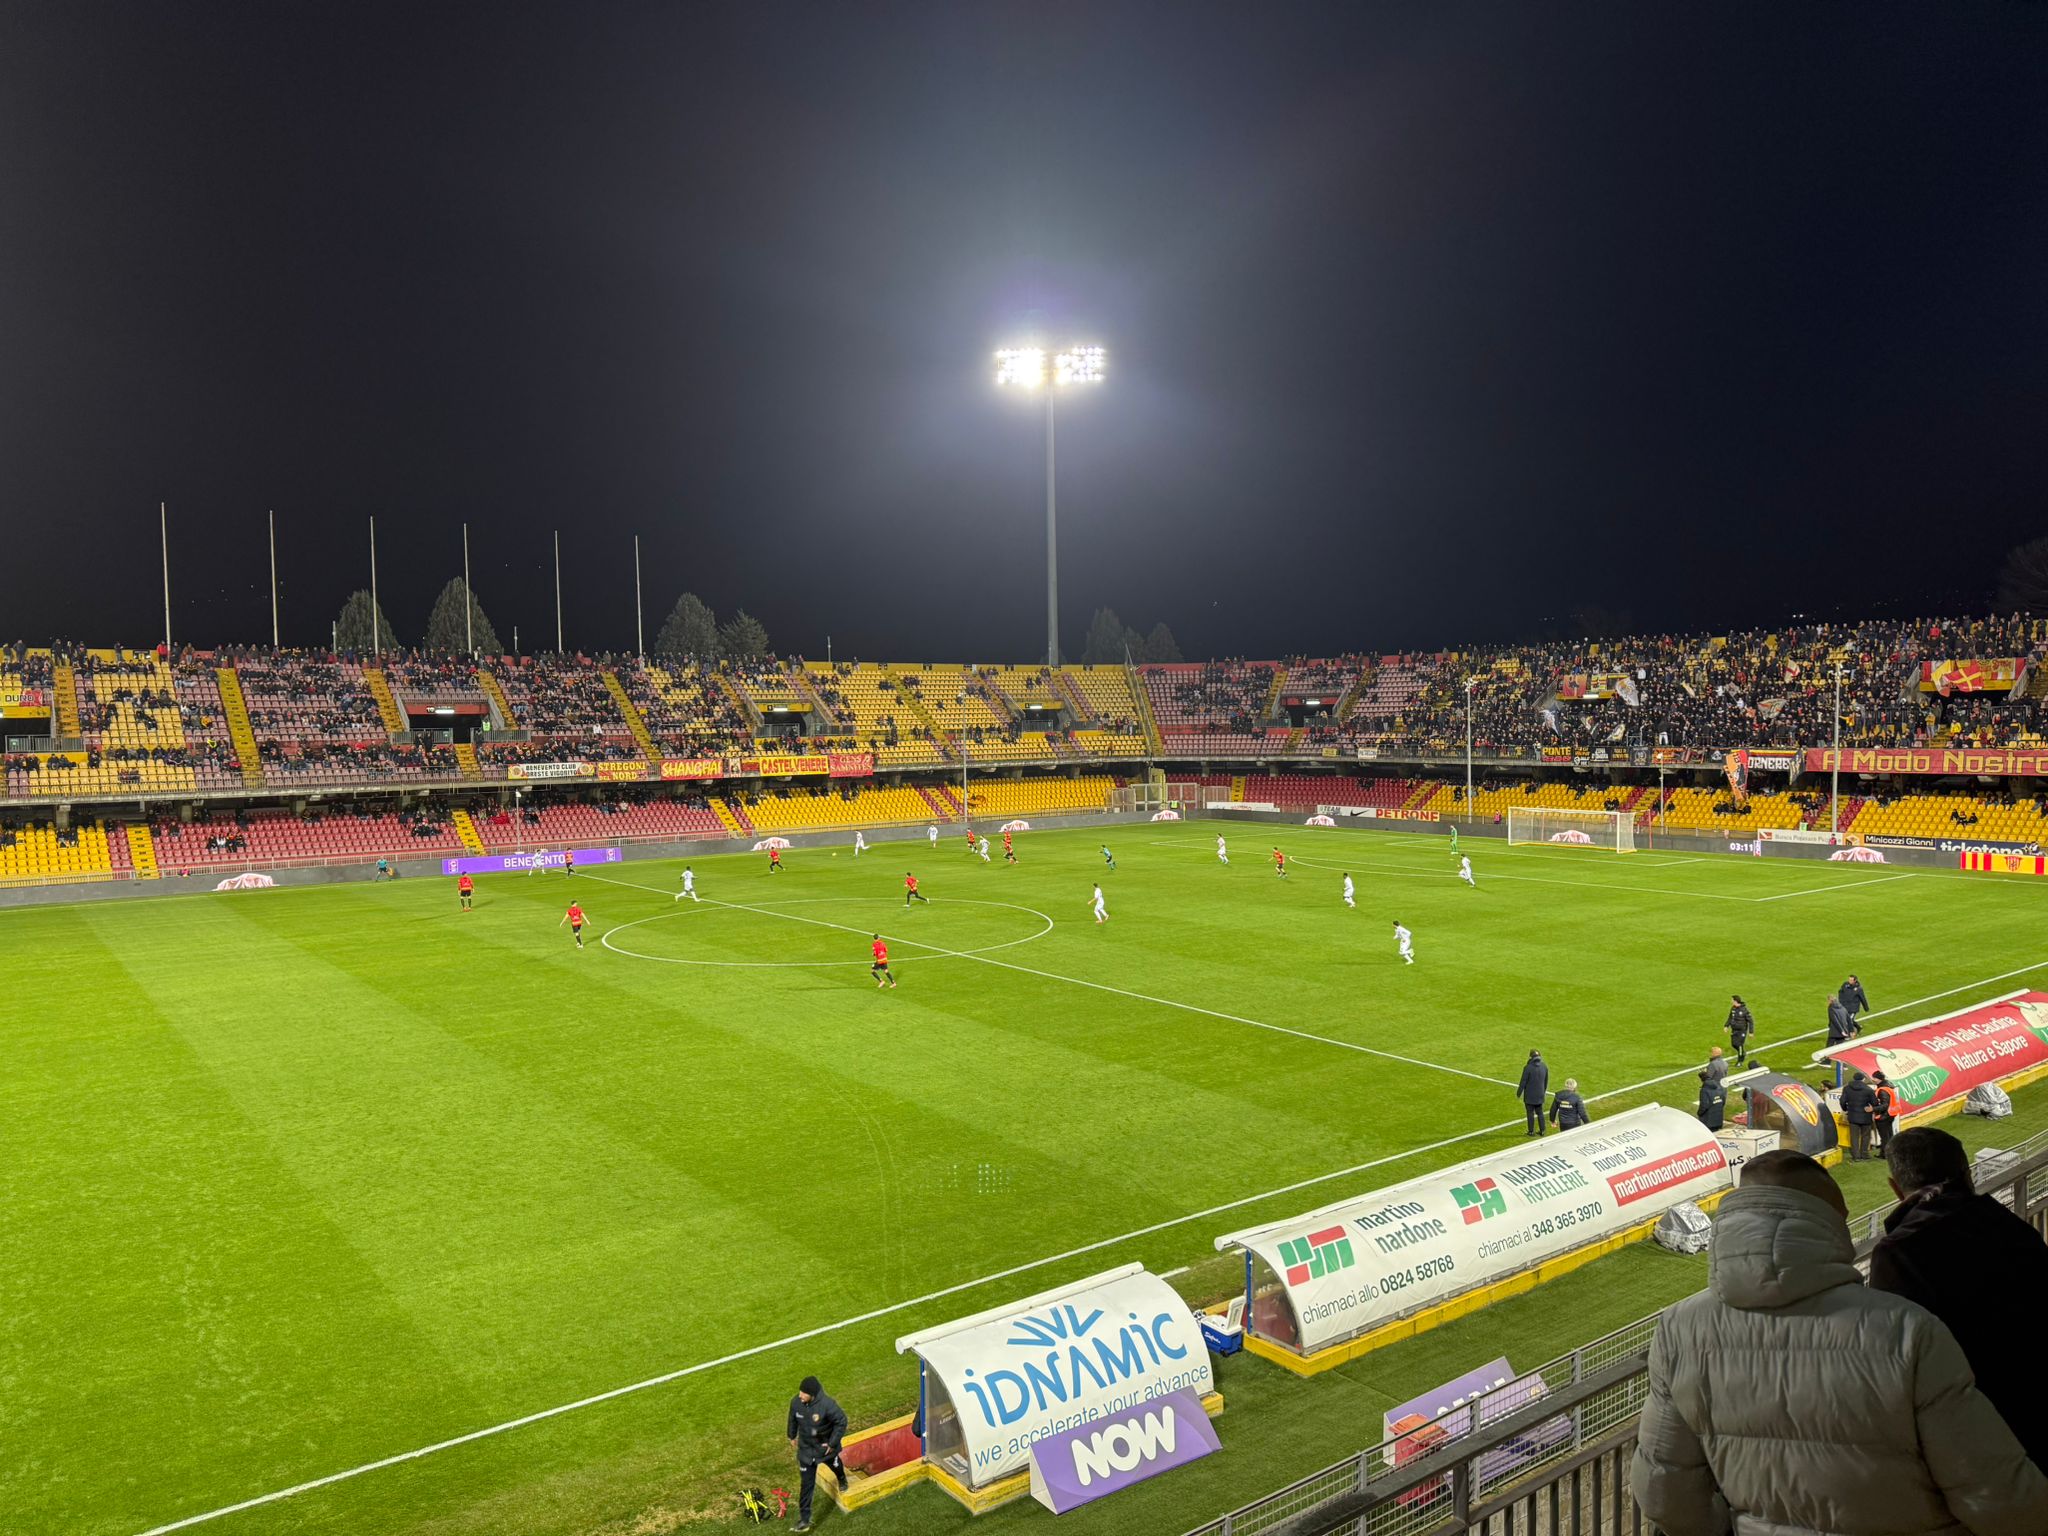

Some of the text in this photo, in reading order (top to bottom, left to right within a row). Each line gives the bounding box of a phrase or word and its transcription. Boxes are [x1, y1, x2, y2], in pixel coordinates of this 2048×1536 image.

[598, 761, 646, 771] STREGONI
[761, 758, 827, 774] CASTELVENERE
[1542, 747, 1571, 756] PONTE
[1823, 750, 2048, 774] A Modo Nostro
[612, 771, 637, 780] NORD
[662, 761, 721, 777] SHANGHAI
[1376, 808, 1440, 822] PETRONE
[1729, 842, 1753, 852] 03:11
[1866, 835, 1934, 847] Minicozzi Gianni
[504, 854, 566, 868] BENEENTO
[1921, 1035, 1960, 1053] Dalla
[1948, 1027, 1977, 1043] Valle
[1973, 1015, 2018, 1038] Caudina
[1951, 1051, 1989, 1072] Natura
[1988, 1047, 1997, 1056] e
[1994, 1033, 2028, 1056] Sapore
[1897, 1071, 1940, 1101] MAURO
[1575, 1127, 1647, 1157] visita il nostro
[1500, 1155, 1573, 1186] NARDONE
[1593, 1145, 1648, 1172] nuovo sito
[1520, 1170, 1589, 1204] HOTELLERIE
[1614, 1148, 1721, 1199] martinonardone.com
[1354, 1202, 1425, 1230] martino
[1478, 1201, 1603, 1259] chiamaci al 348 365 3970
[1374, 1218, 1447, 1253] nardone
[1302, 1255, 1455, 1324] chiamaci allo 0824 58768
[975, 1446, 1002, 1467] we
[1008, 1405, 1099, 1454] accelerate
[1103, 1391, 1139, 1416] your
[1145, 1365, 1209, 1401] advance
[1071, 1406, 1175, 1486] NOW
